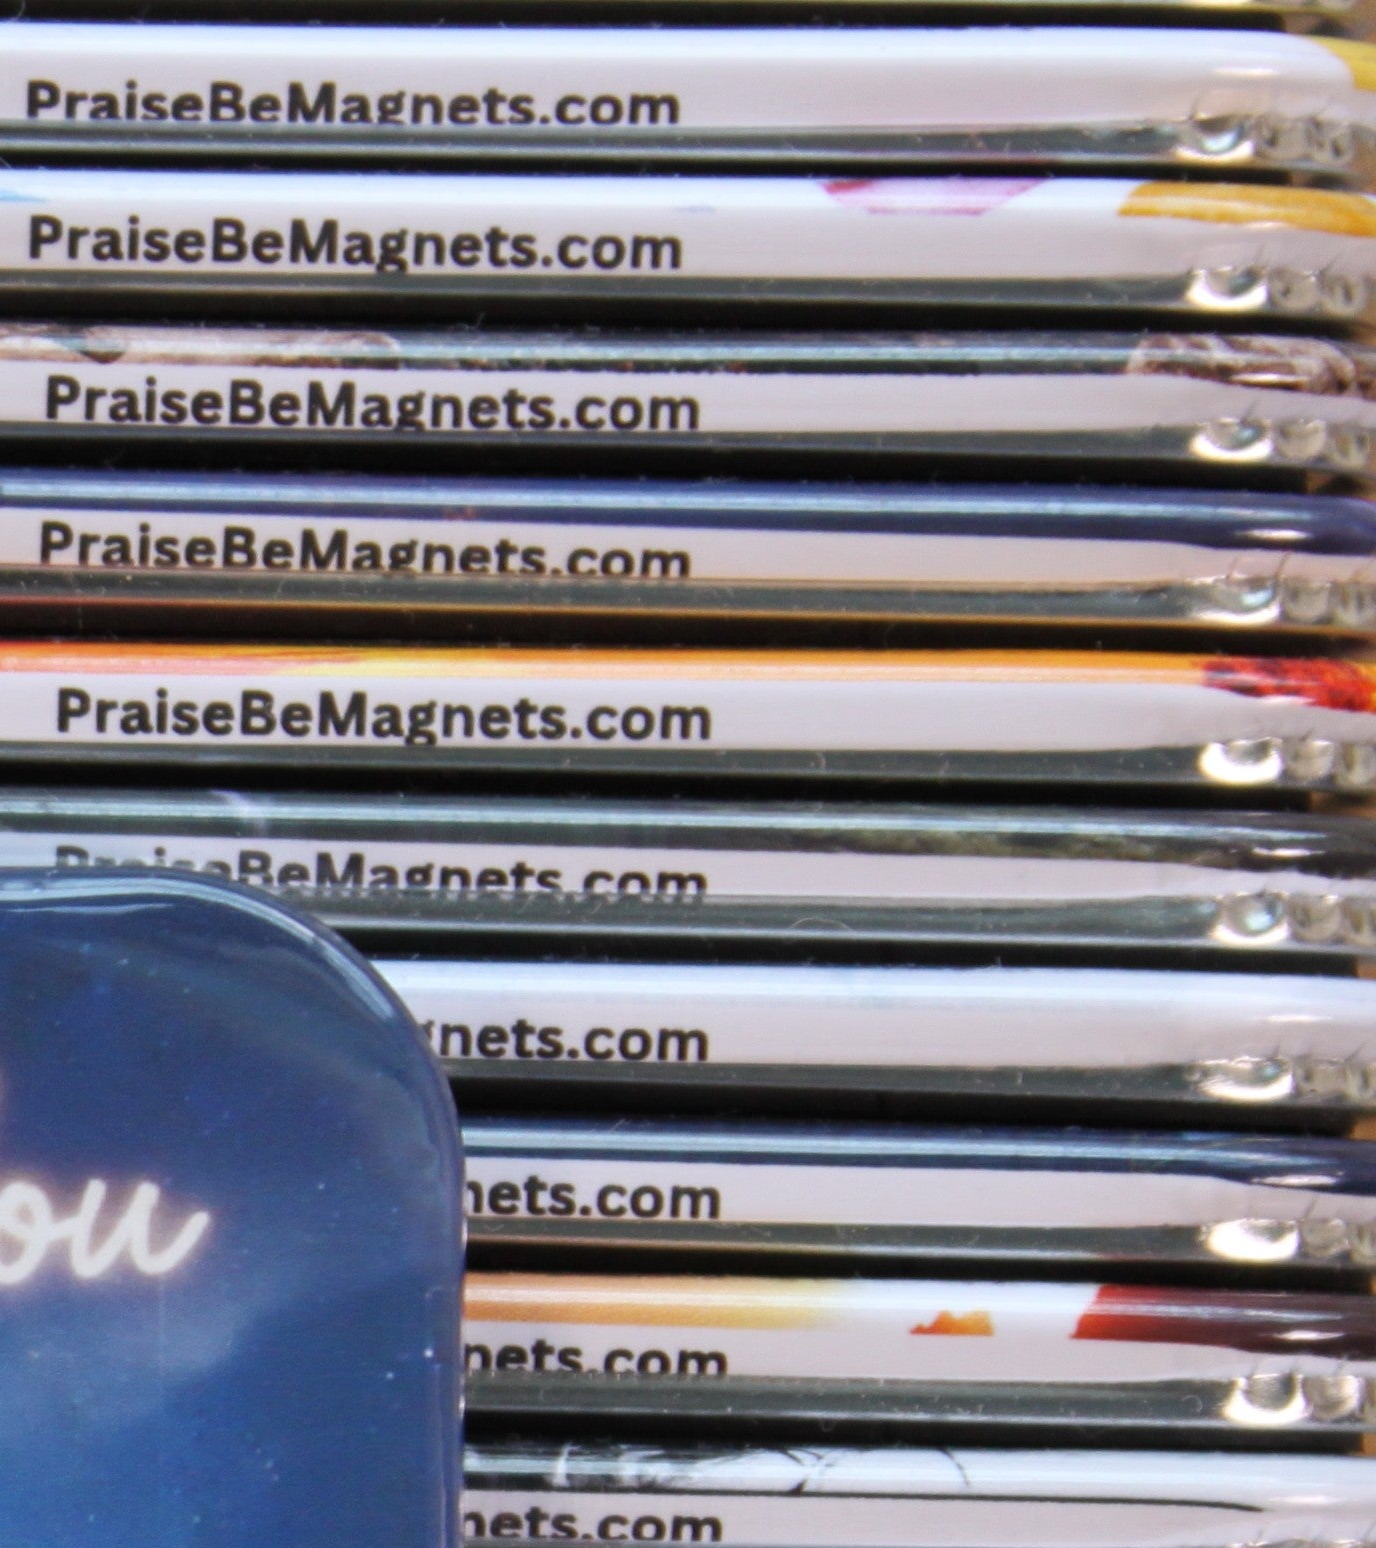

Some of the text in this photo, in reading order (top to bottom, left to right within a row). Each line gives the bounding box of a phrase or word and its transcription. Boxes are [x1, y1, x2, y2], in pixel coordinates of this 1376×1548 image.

[26, 79, 681, 127] PraiseBeMagnets.com
[28, 214, 683, 273] PraiseBeMagnets.com
[45, 374, 700, 434] PraiseBeMagnets.com
[40, 521, 691, 578] PraiseBeMagnets.com
[55, 687, 712, 747] PraiseBeMagnets.com
